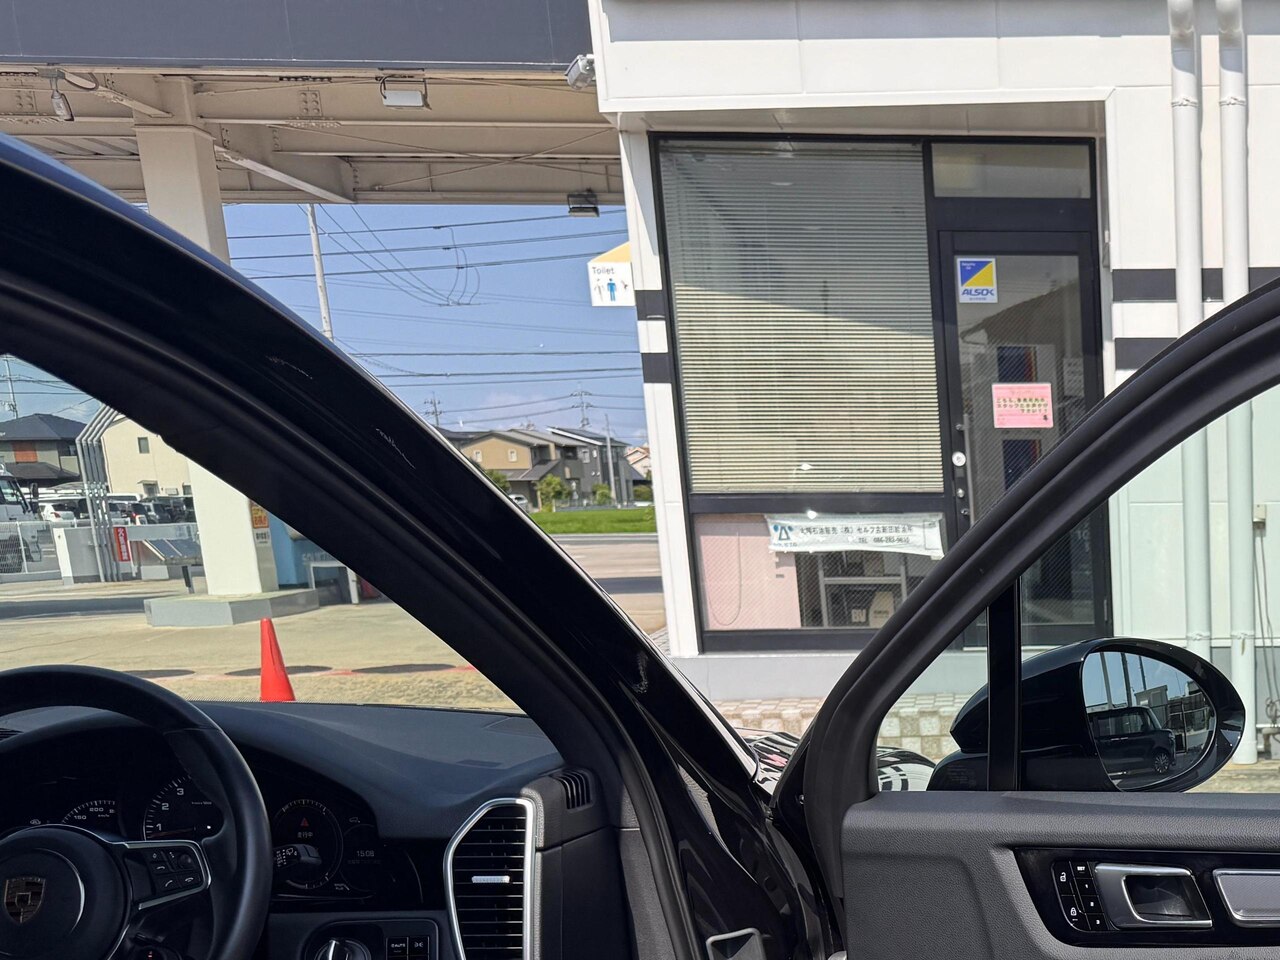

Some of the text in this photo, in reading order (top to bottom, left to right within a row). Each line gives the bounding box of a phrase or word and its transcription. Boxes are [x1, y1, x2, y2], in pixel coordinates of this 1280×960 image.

[591, 266, 615, 275] Toilet
[961, 288, 995, 297] ALSOK
[176, 788, 185, 796] 3
[161, 803, 170, 811] 2
[156, 823, 162, 831] 1
